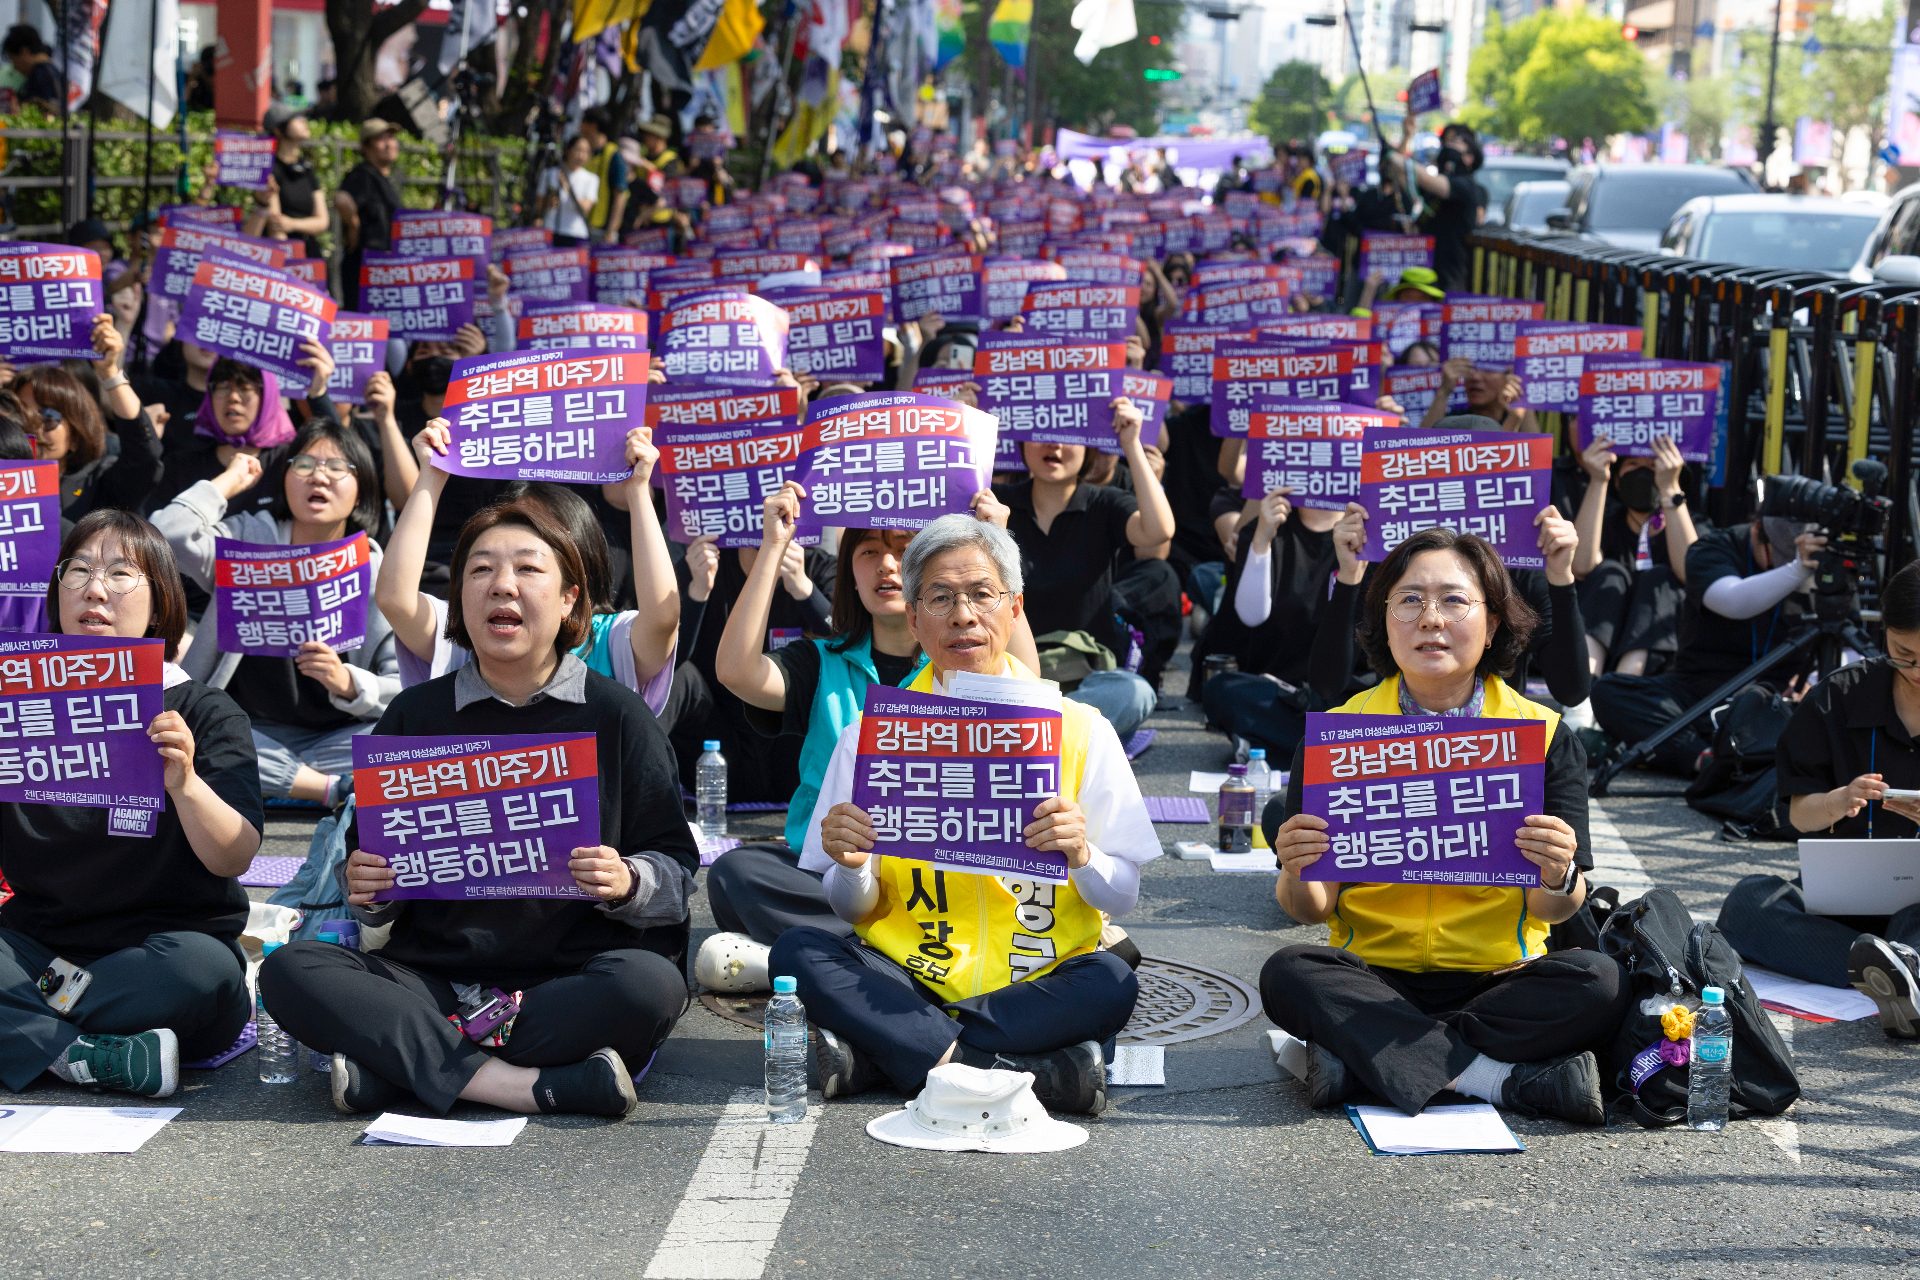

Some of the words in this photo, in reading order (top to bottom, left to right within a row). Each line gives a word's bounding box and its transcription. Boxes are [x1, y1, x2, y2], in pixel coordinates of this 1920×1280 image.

[23, 255, 88, 278] 10주기!
[42, 282, 94, 309] 딛고
[211, 267, 266, 297] 강남역
[270, 282, 324, 315] 10주기!
[202, 291, 271, 327] 추모를
[276, 308, 320, 340] 딛고
[672, 303, 720, 327] 강남역
[819, 297, 870, 320] 10주기!
[195, 316, 294, 360] 행동하라!
[666, 325, 730, 349] 추모를
[789, 325, 828, 349] 모를
[833, 319, 874, 344] 딛고
[332, 343, 374, 364] 딛고
[463, 368, 475, 376] 5.17
[476, 362, 496, 373] 강남역
[498, 354, 540, 368] 여성살해사건
[541, 352, 563, 362] 10주기
[665, 349, 759, 375] 행동하라!
[990, 349, 1044, 372] 강남역
[1049, 346, 1108, 369] 10주기!
[1228, 358, 1279, 378] 강남역
[1282, 355, 1337, 376] 10주기!
[466, 366, 538, 398] 강남역
[544, 357, 623, 387] 10주기!
[987, 375, 1056, 402] 추모를
[1064, 373, 1111, 398] 딛고
[1595, 374, 1645, 392] 강남역
[1650, 370, 1704, 390] 10주기!
[459, 396, 553, 432] 추모를
[565, 390, 627, 423] 딛고
[660, 402, 717, 423] 강남역
[719, 394, 781, 420] 10주기!
[816, 411, 827, 419] 5.17
[828, 405, 849, 415] 강남역
[850, 398, 892, 410] 여성살해사건
[893, 396, 915, 405] 10주기
[1592, 394, 1655, 419] 추모를
[1662, 394, 1704, 416] 딛고
[820, 410, 890, 442] 강남역
[1266, 416, 1322, 436] 강남역
[459, 428, 594, 468] 행동하라!
[1262, 441, 1333, 466] 추모를
[1374, 441, 1386, 449] 5.17
[1409, 436, 1450, 446] 여성살해사건
[1451, 434, 1471, 443] 10주기
[673, 443, 734, 470] 강남역
[812, 442, 905, 476] 추모를
[917, 440, 978, 470] 딛고
[1381, 449, 1450, 478] 강남역
[1455, 443, 1530, 472] 10주기!
[675, 472, 750, 504] 추모를
[812, 476, 945, 514] 행동하라!
[1379, 481, 1466, 515] 추모를
[1476, 476, 1534, 509] 딛고
[230, 562, 293, 585] 강남역
[296, 544, 357, 582] 10주기!
[231, 589, 310, 617] 추모를
[317, 572, 361, 611] 딛고
[236, 610, 342, 646] 행동하라!
[32, 639, 58, 649] 10주기
[38, 650, 134, 687] 10주기!
[67, 694, 143, 734] 딛고
[874, 704, 885, 712] 5.17
[887, 704, 908, 713] 강남역
[911, 704, 959, 715] 여성살해사건
[961, 707, 986, 716] 10주기
[877, 721, 957, 752] 강남역
[966, 721, 1052, 752] 10주기!
[1321, 731, 1335, 741] 5.17
[1338, 729, 1363, 739] 강남역
[1365, 724, 1416, 737] 여성살해사건
[1417, 722, 1443, 732] 10주기
[368, 752, 382, 763] 5.17
[385, 751, 410, 762] 강남역
[412, 744, 464, 759] 여성살해사건
[465, 741, 490, 753] 10주기
[1330, 741, 1417, 777] 강남역
[1423, 731, 1516, 769] 10주기!
[379, 762, 467, 799] 강남역
[472, 746, 569, 787] 10주기!
[868, 760, 975, 798] 추모를
[989, 763, 1057, 799] 딛고
[24, 790, 160, 808] 젠더폭력해결페미니스트연대
[1328, 780, 1437, 823] 추모를
[1450, 773, 1523, 814] 딛고
[114, 808, 152, 821] AGAINST
[114, 821, 147, 832] WOMEN
[382, 799, 492, 844] 추모를
[502, 788, 579, 831] 딛고
[868, 805, 1021, 842] 행동하라!
[1331, 821, 1488, 868] 행동하라!
[389, 837, 548, 887] 행동하라!
[935, 849, 1065, 876] 젠더폭력해결페미니스트연대
[1402, 870, 1536, 884] 젠더폭력해결페미니스트연대
[1702, 1048, 1724, 1056] 백산수
